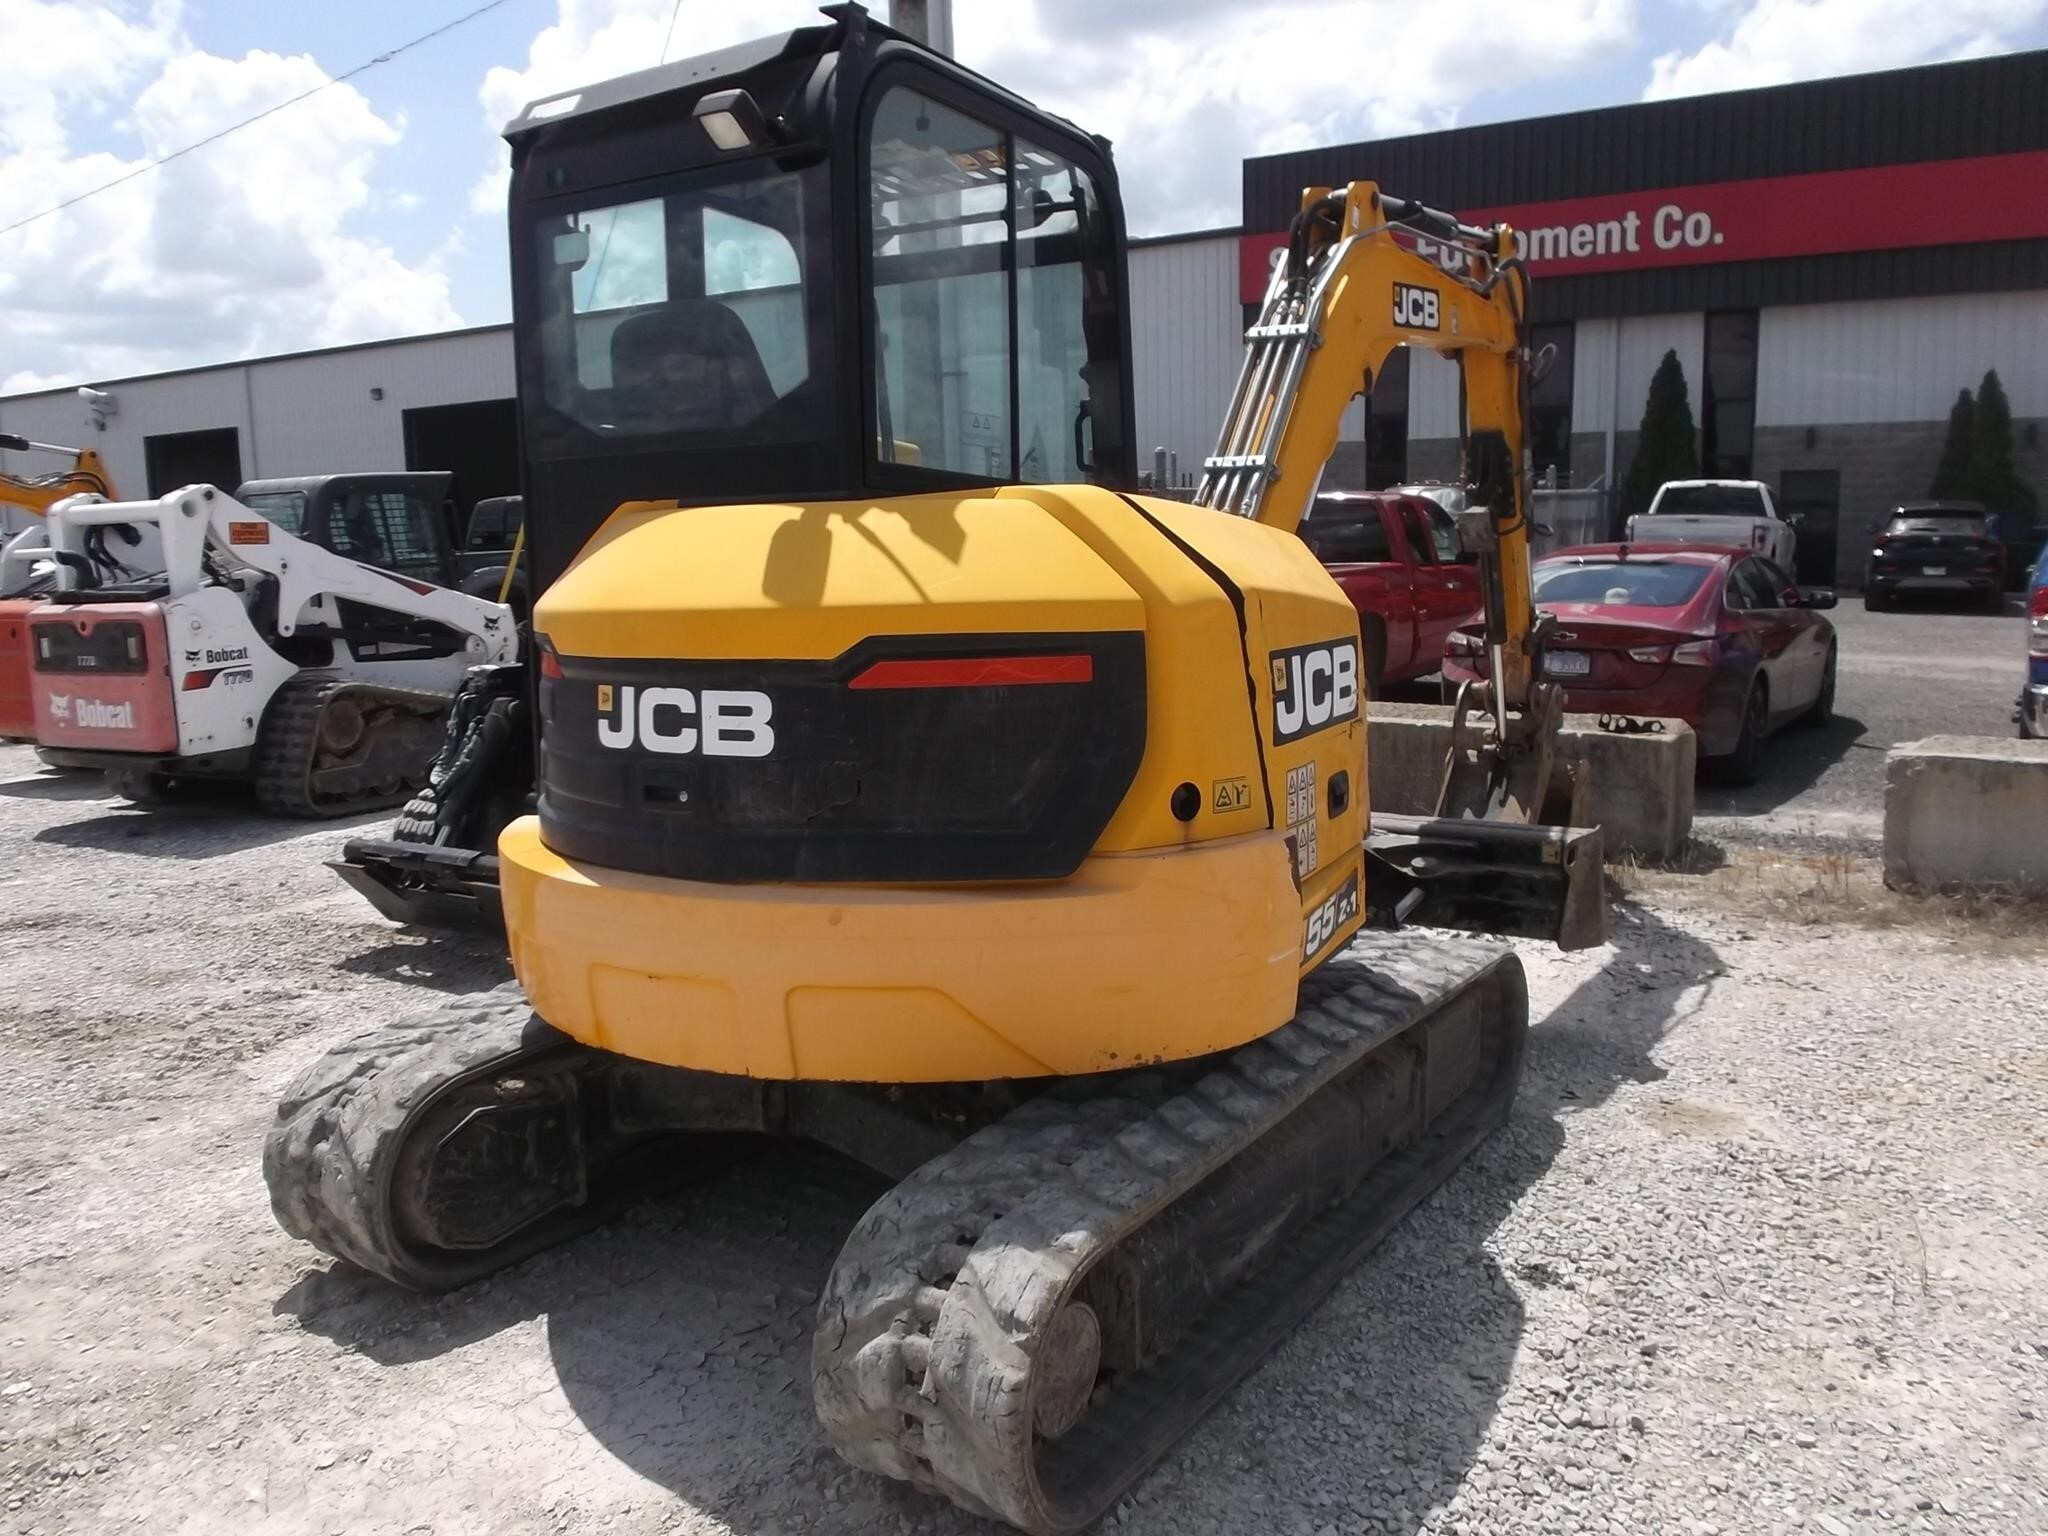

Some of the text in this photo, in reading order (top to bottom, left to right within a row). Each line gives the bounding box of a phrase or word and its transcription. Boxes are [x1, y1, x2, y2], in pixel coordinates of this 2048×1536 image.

[1653, 204, 1724, 250] Co.
[1394, 286, 1440, 328] JCB
[206, 646, 249, 663] Bobcat
[1277, 643, 1358, 735] JCB
[76, 698, 133, 729] Bobcat
[598, 685, 775, 757] JCB
[1306, 893, 1337, 955] 55
